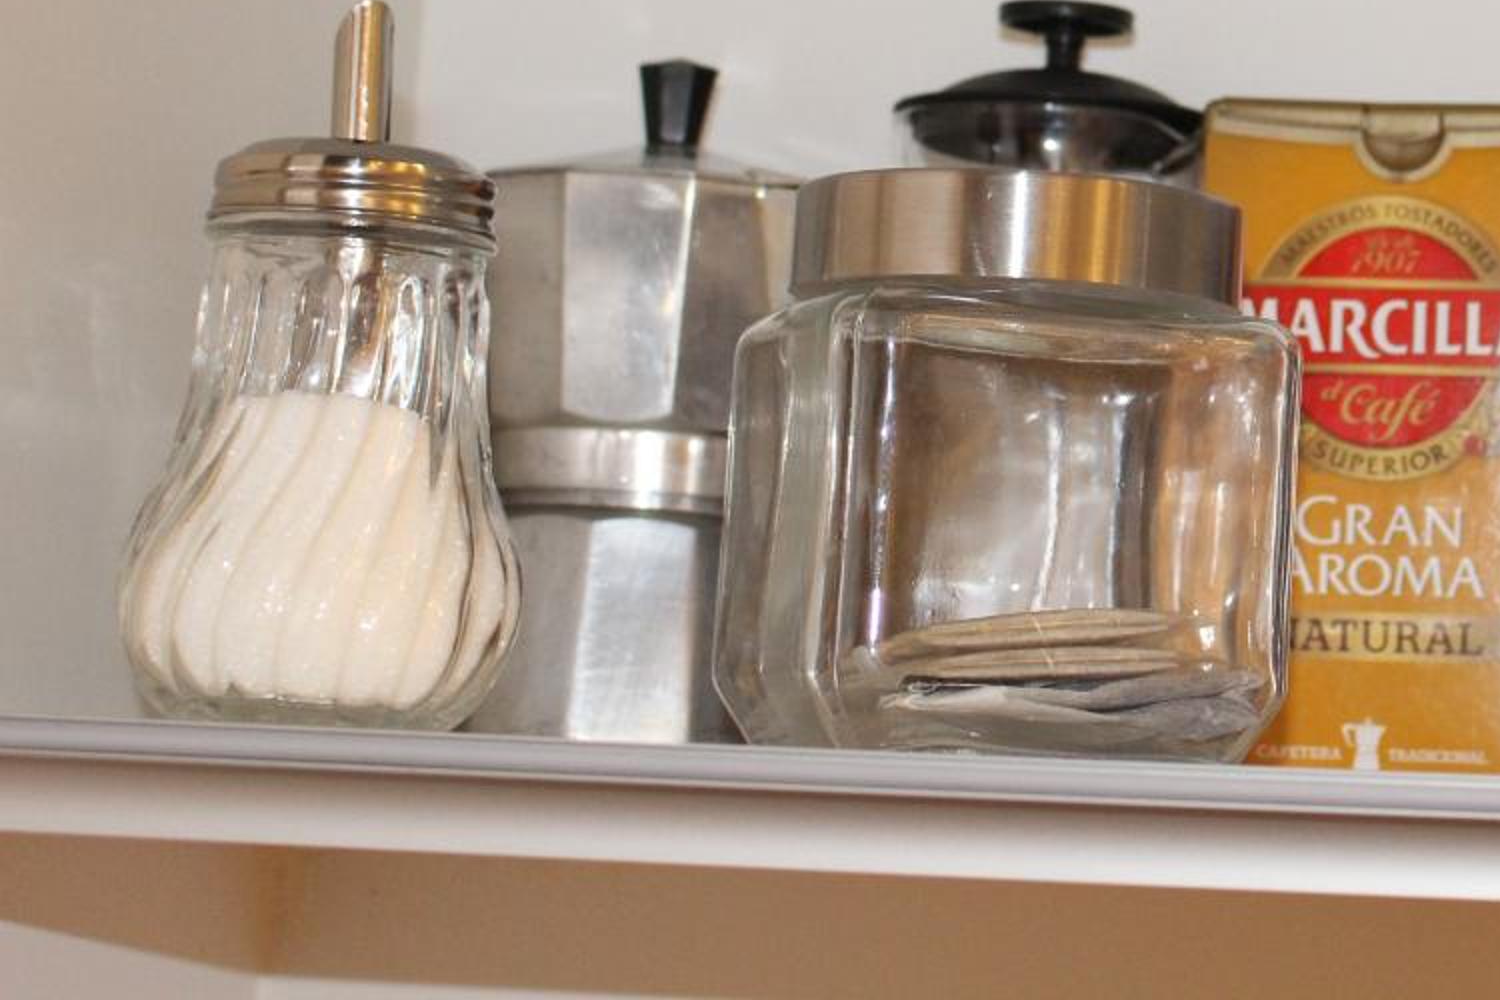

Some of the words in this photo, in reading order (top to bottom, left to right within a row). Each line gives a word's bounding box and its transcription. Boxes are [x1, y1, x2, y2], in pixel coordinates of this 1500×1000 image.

[1339, 377, 1442, 441] Café
[1312, 439, 1450, 475] SUPERIOR
[1296, 494, 1463, 549] GRAN
[1291, 549, 1485, 600] AROMA
